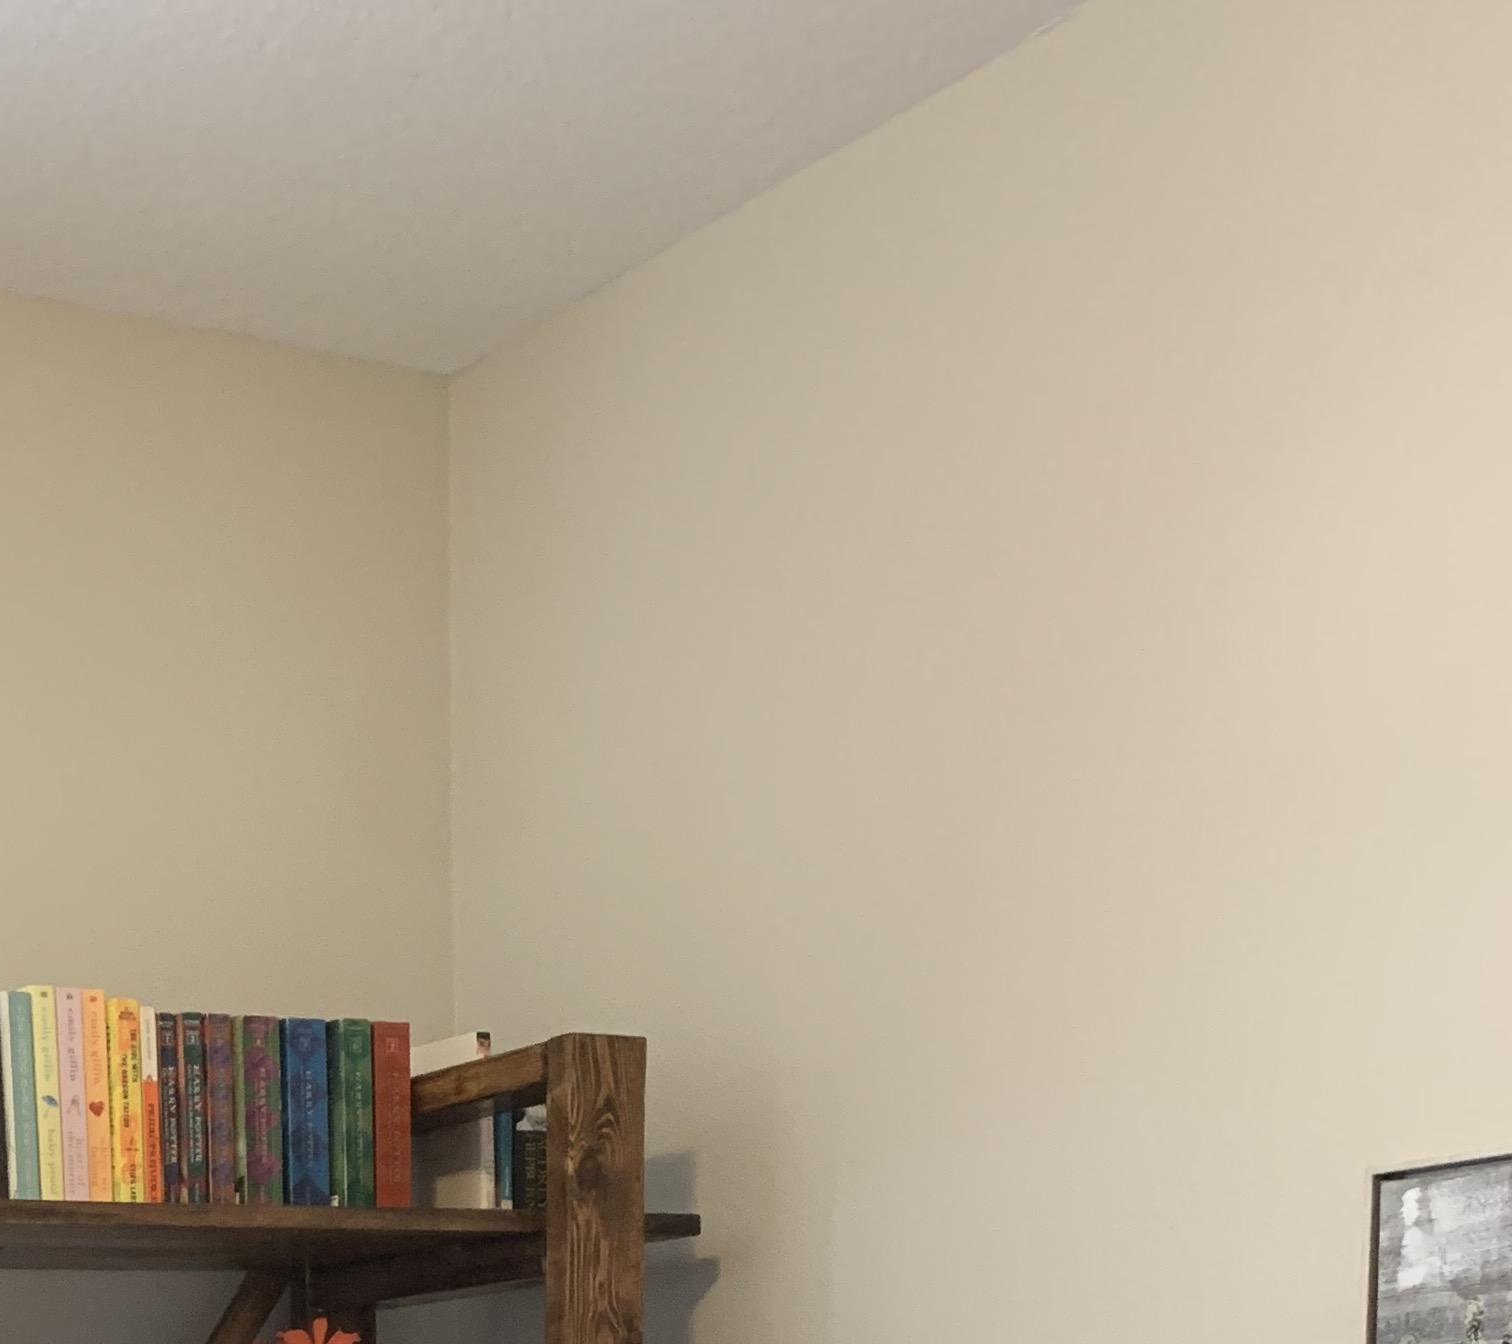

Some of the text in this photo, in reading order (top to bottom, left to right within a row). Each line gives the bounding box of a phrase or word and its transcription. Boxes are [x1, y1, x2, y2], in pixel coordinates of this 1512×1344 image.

[67, 1047, 79, 1081] giffin
[91, 1050, 103, 1083] giffin
[305, 1070, 314, 1115] HARRY
[193, 1064, 203, 1162] HARRY POTTER
